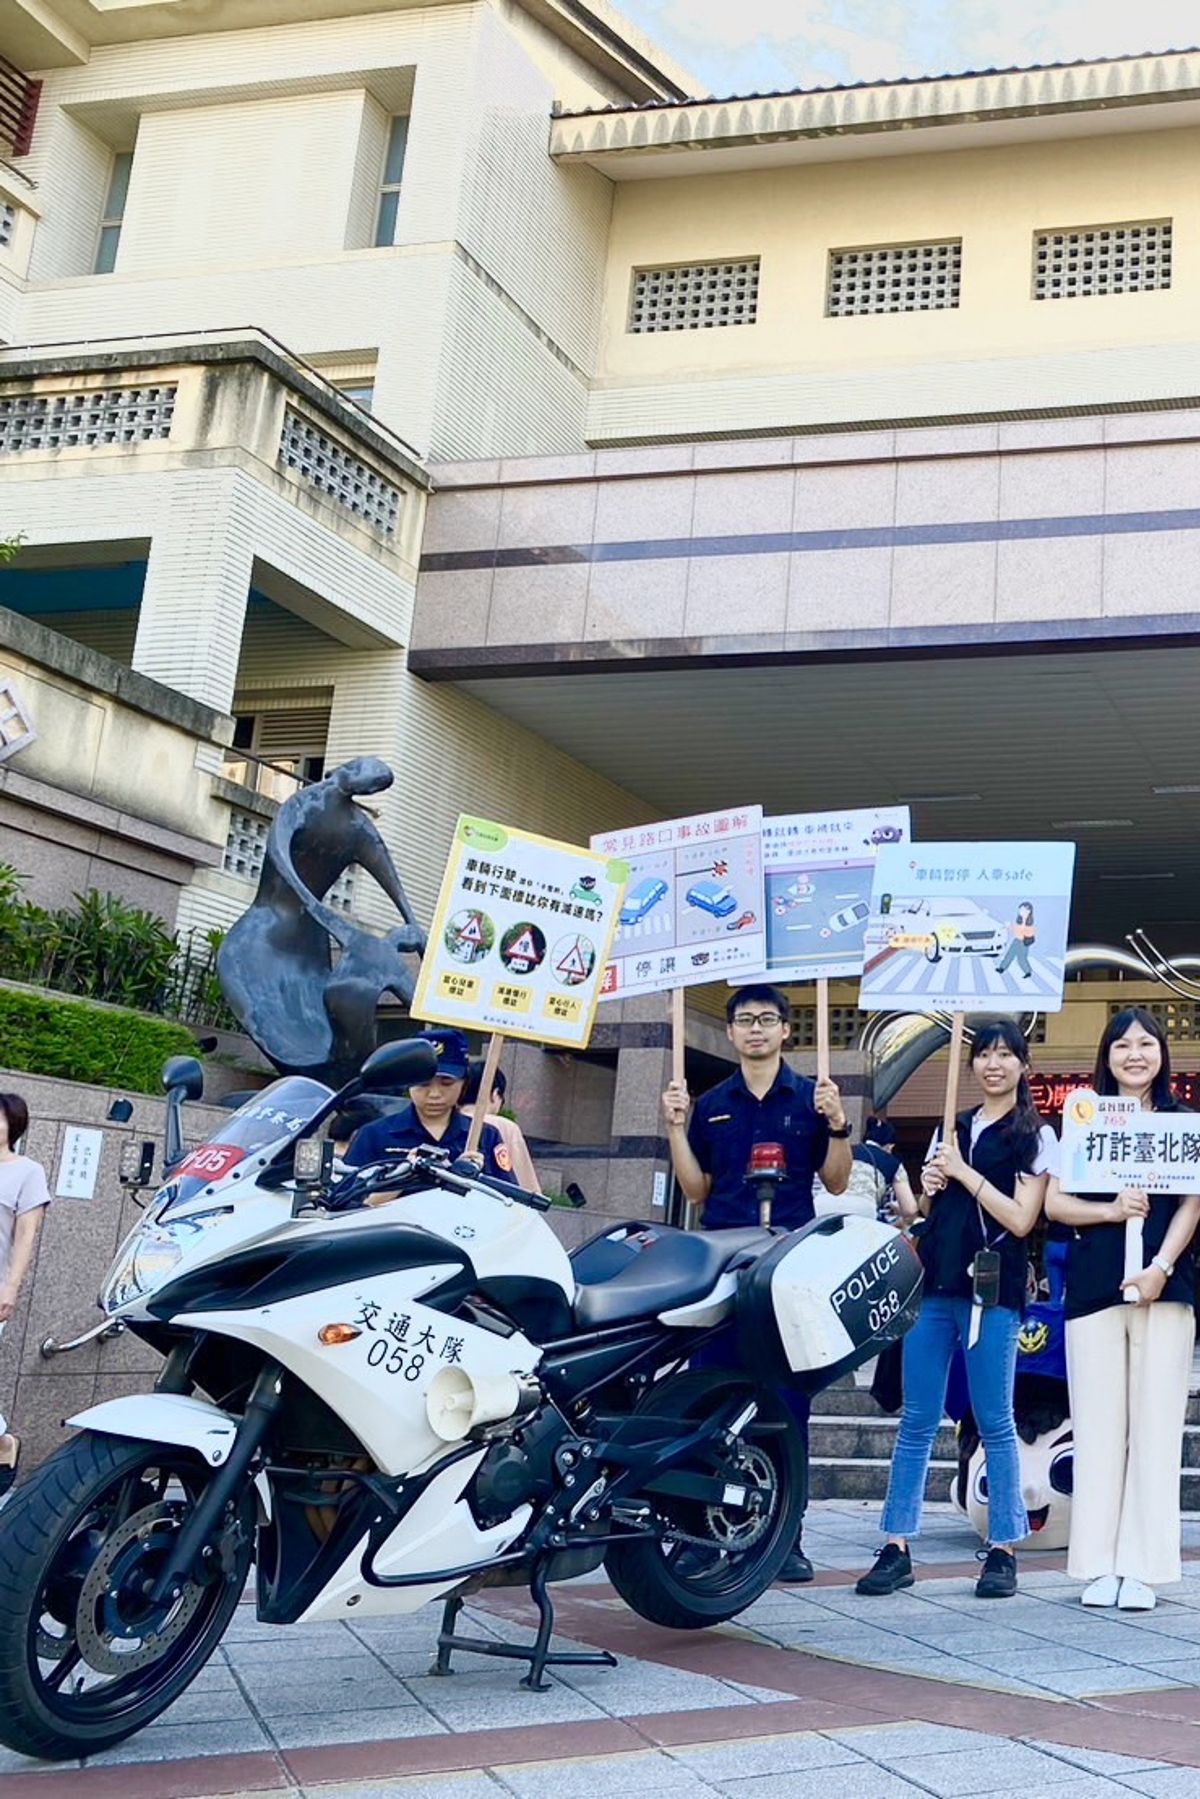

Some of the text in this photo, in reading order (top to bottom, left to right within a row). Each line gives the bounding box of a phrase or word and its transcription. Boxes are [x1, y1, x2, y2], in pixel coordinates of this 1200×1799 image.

[603, 814, 749, 853] 常見路口事故圖解
[465, 858, 516, 885] 車輛行駛
[635, 957, 677, 980] 停讓
[831, 1242, 900, 1314] POLICE
[868, 1290, 900, 1331] 058
[353, 1300, 465, 1363] 交通大隊
[367, 1338, 425, 1382] 058
